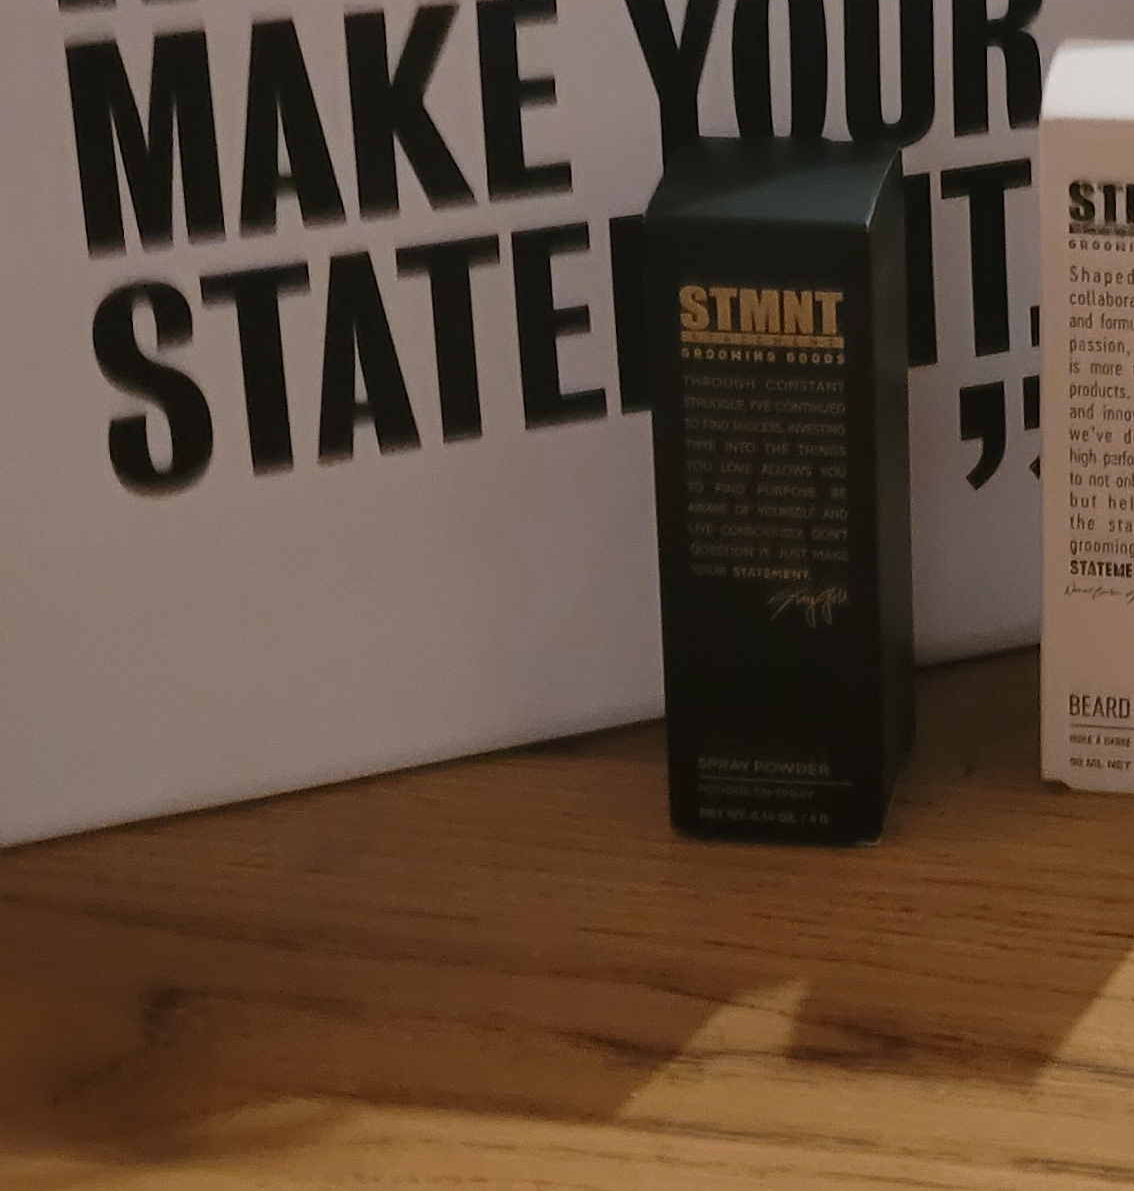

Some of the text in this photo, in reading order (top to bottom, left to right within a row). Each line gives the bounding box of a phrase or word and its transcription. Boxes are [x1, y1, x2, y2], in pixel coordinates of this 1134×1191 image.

[679, 285, 844, 337] STMNT
[92, 158, 1042, 500] STATET
[1069, 314, 1094, 329] and
[1069, 337, 1132, 357] passion,
[681, 348, 846, 366] GROOMING GOODS
[1069, 361, 1081, 375] is
[1090, 363, 1124, 377] more
[683, 374, 845, 393] THROUGH CONSTANT
[1069, 382, 1131, 400] products.
[1069, 405, 1095, 421] and
[684, 417, 701, 430] TO
[1069, 427, 1113, 443] we've
[724, 440, 756, 454] INTO
[764, 441, 790, 455] THE
[1069, 448, 1097, 468] high
[820, 465, 847, 479] YOU
[1069, 472, 1083, 486] to
[1088, 474, 1109, 489] not
[1069, 492, 1097, 510] but
[1069, 514, 1096, 531] the
[1068, 693, 1132, 719] BEARD
[752, 760, 831, 776] POWDER
[1107, 759, 1132, 771] NET
